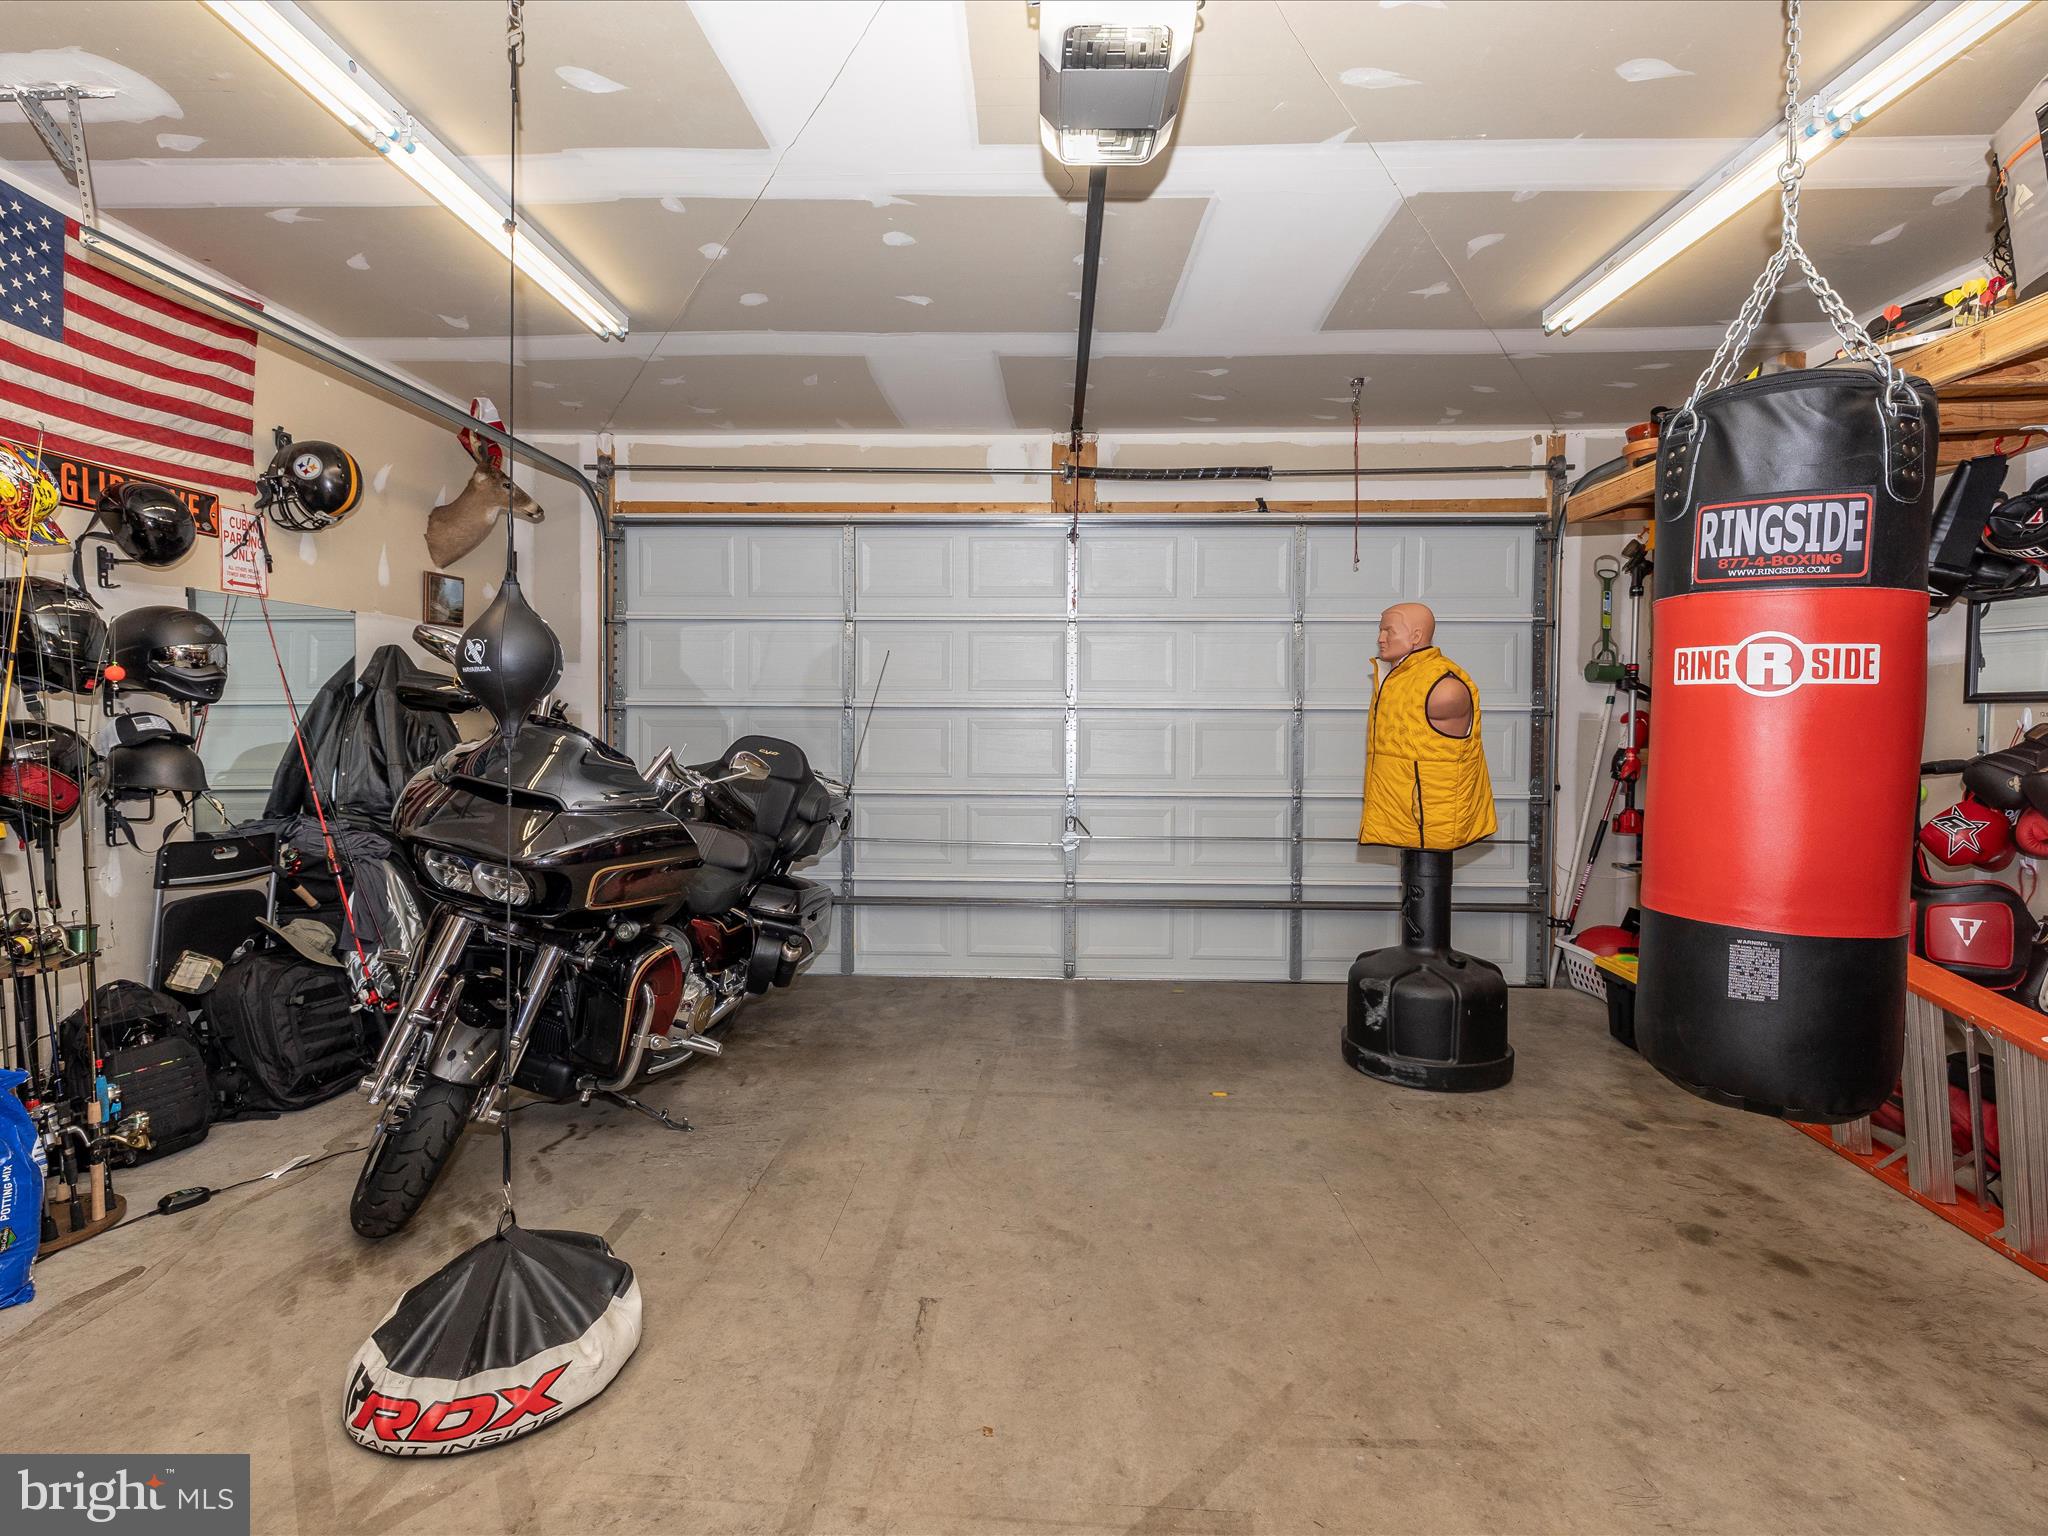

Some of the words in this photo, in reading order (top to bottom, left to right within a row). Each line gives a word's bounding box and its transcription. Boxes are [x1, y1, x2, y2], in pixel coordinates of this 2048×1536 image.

[223, 530, 263, 549] PARING
[1700, 500, 1865, 560] RINGSIDE
[231, 549, 256, 562] ONLY
[1718, 553, 1842, 569] 877-4-BOXING
[1728, 566, 1830, 577] WWW.RINGSIDE.COM
[1677, 649, 1730, 681] RING
[1746, 643, 1793, 685] R
[1812, 648, 1876, 680] SIDE
[2, 1164, 12, 1181] MIX
[0, 1182, 12, 1221] POTTING
[351, 1360, 573, 1443] RDX
